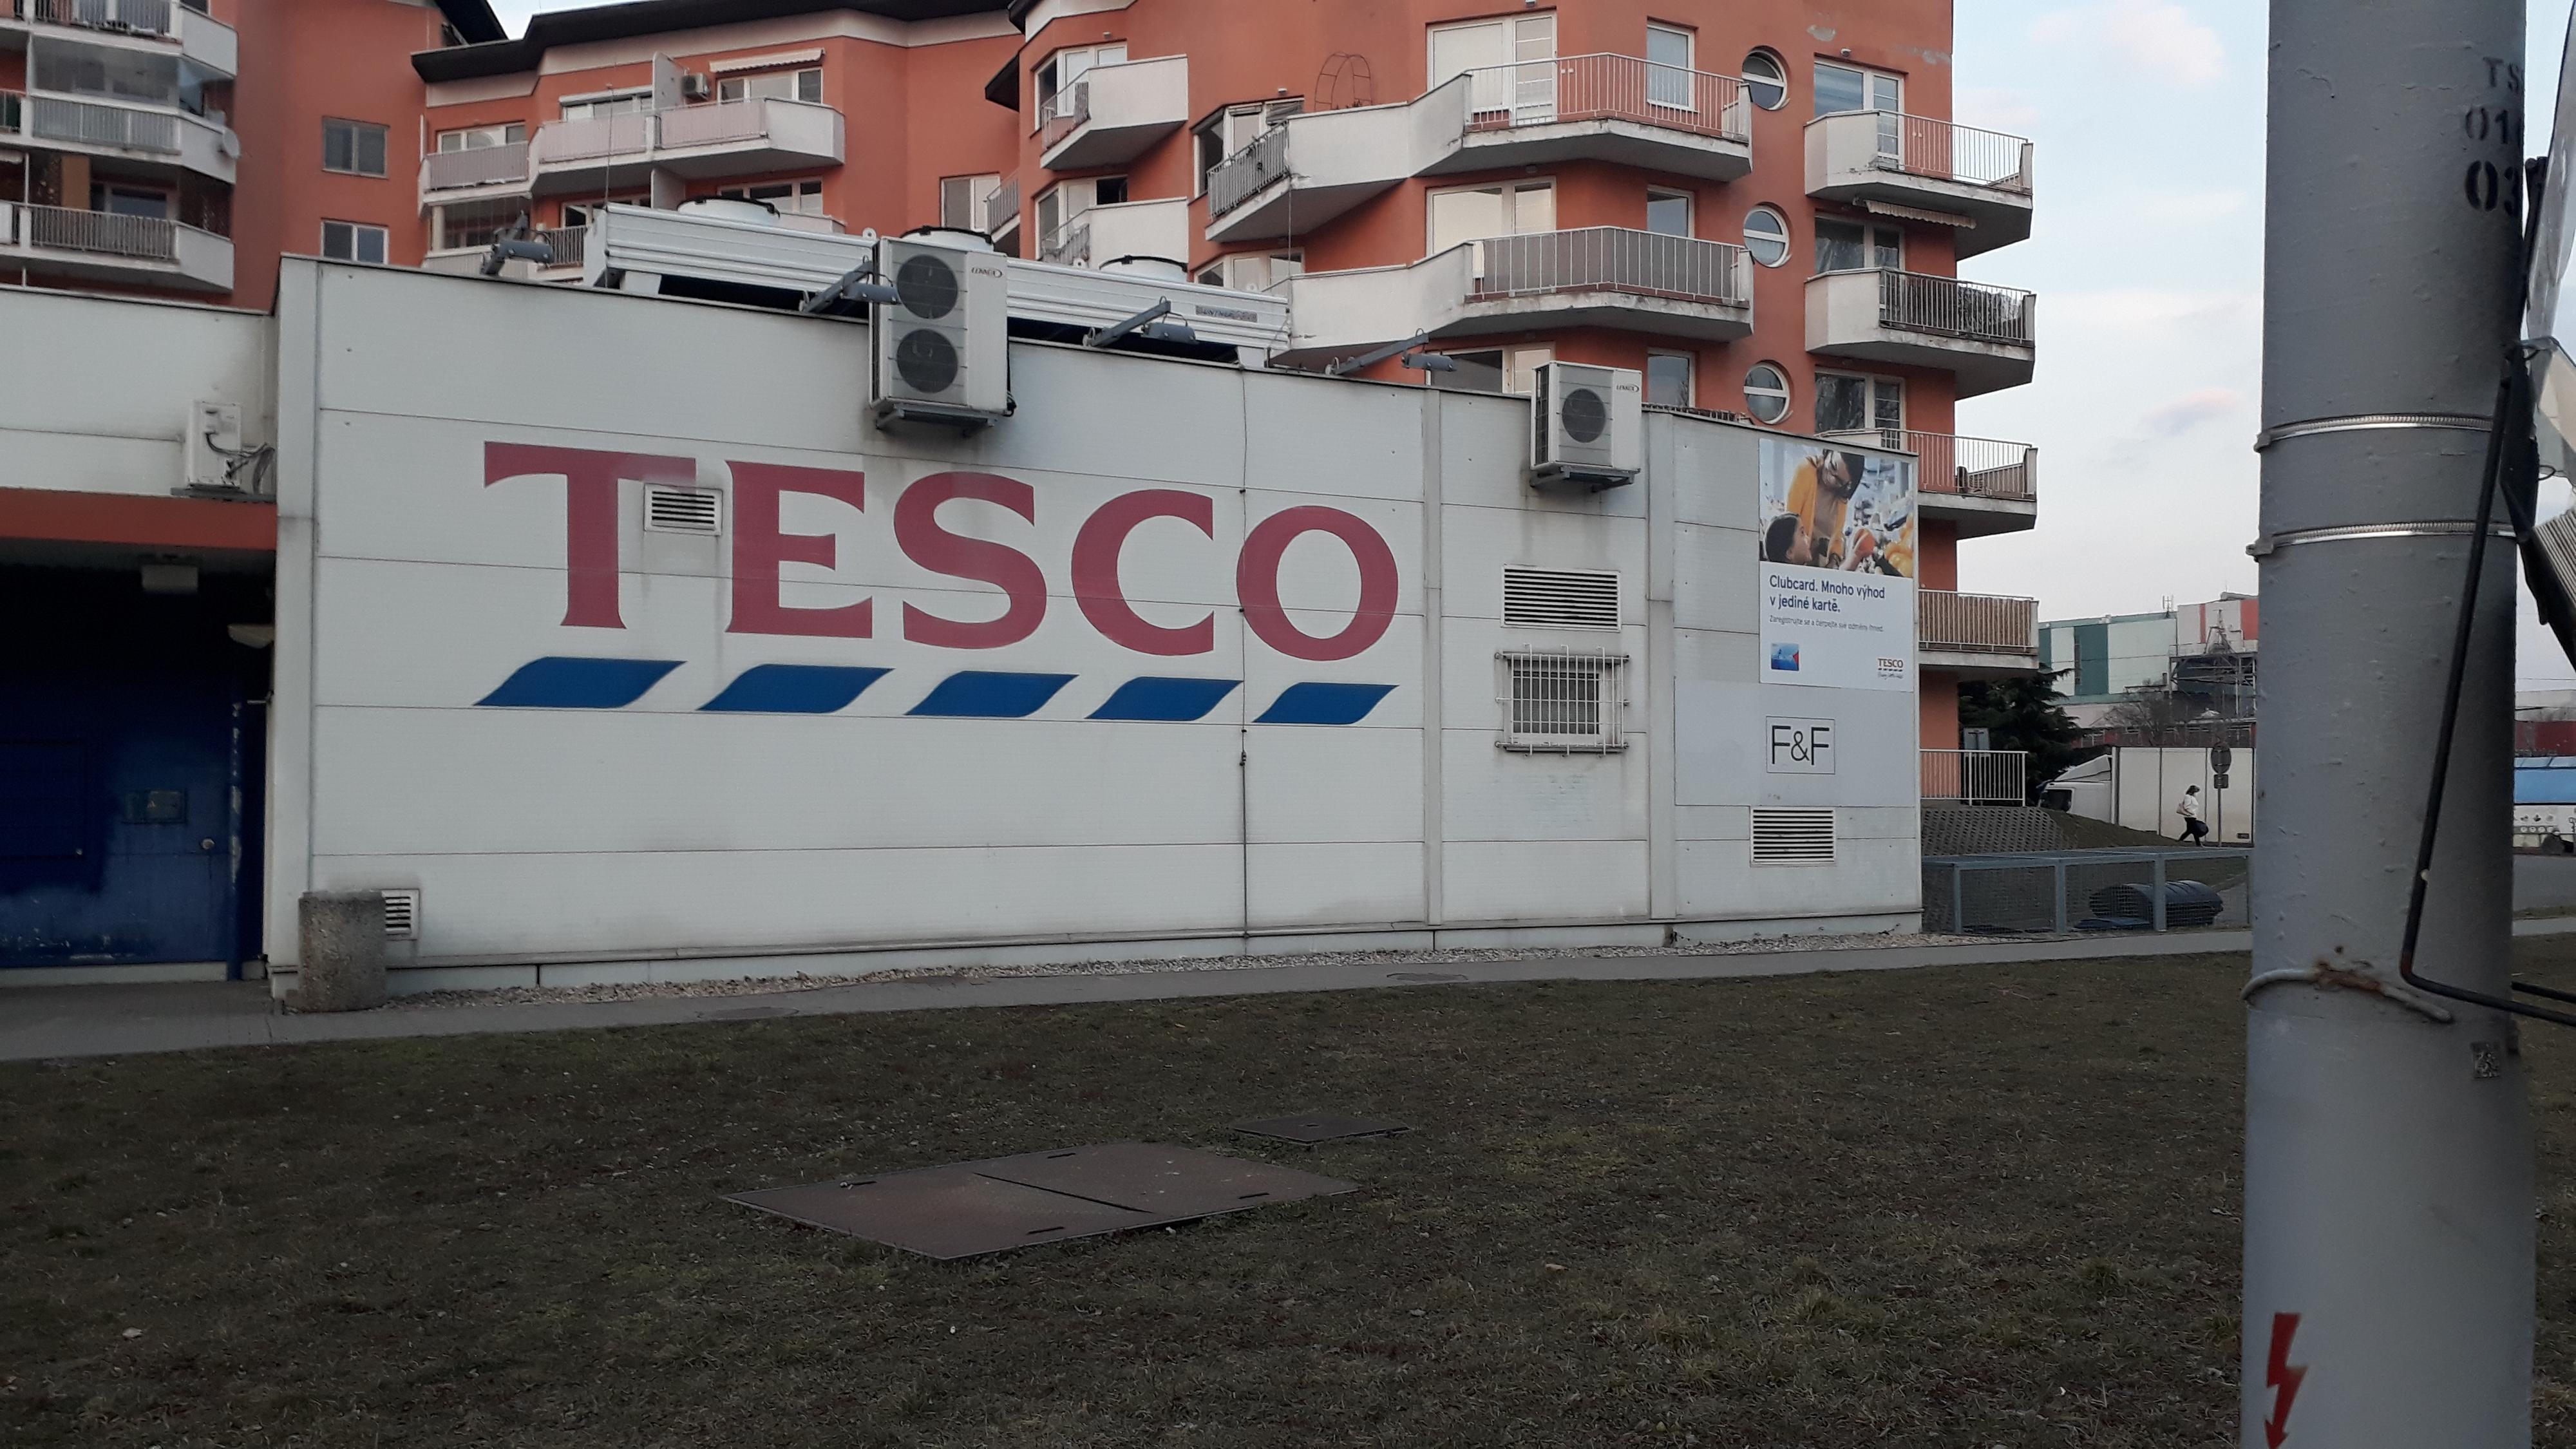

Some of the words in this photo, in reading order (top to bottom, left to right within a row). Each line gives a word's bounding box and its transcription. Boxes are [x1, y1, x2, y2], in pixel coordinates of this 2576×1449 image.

[2483, 57, 2523, 94] TS
[484, 441, 1398, 661] TESCO
[1769, 574, 1818, 592] Clubcard.
[1821, 581, 1854, 596] Mnoho
[1857, 584, 1885, 600] výhod
[1770, 596, 1776, 606] v
[1778, 594, 1809, 610] jediné
[1812, 598, 1841, 612] kartě.
[1878, 658, 1904, 668] TESCO
[1772, 725, 1830, 766] F&F
